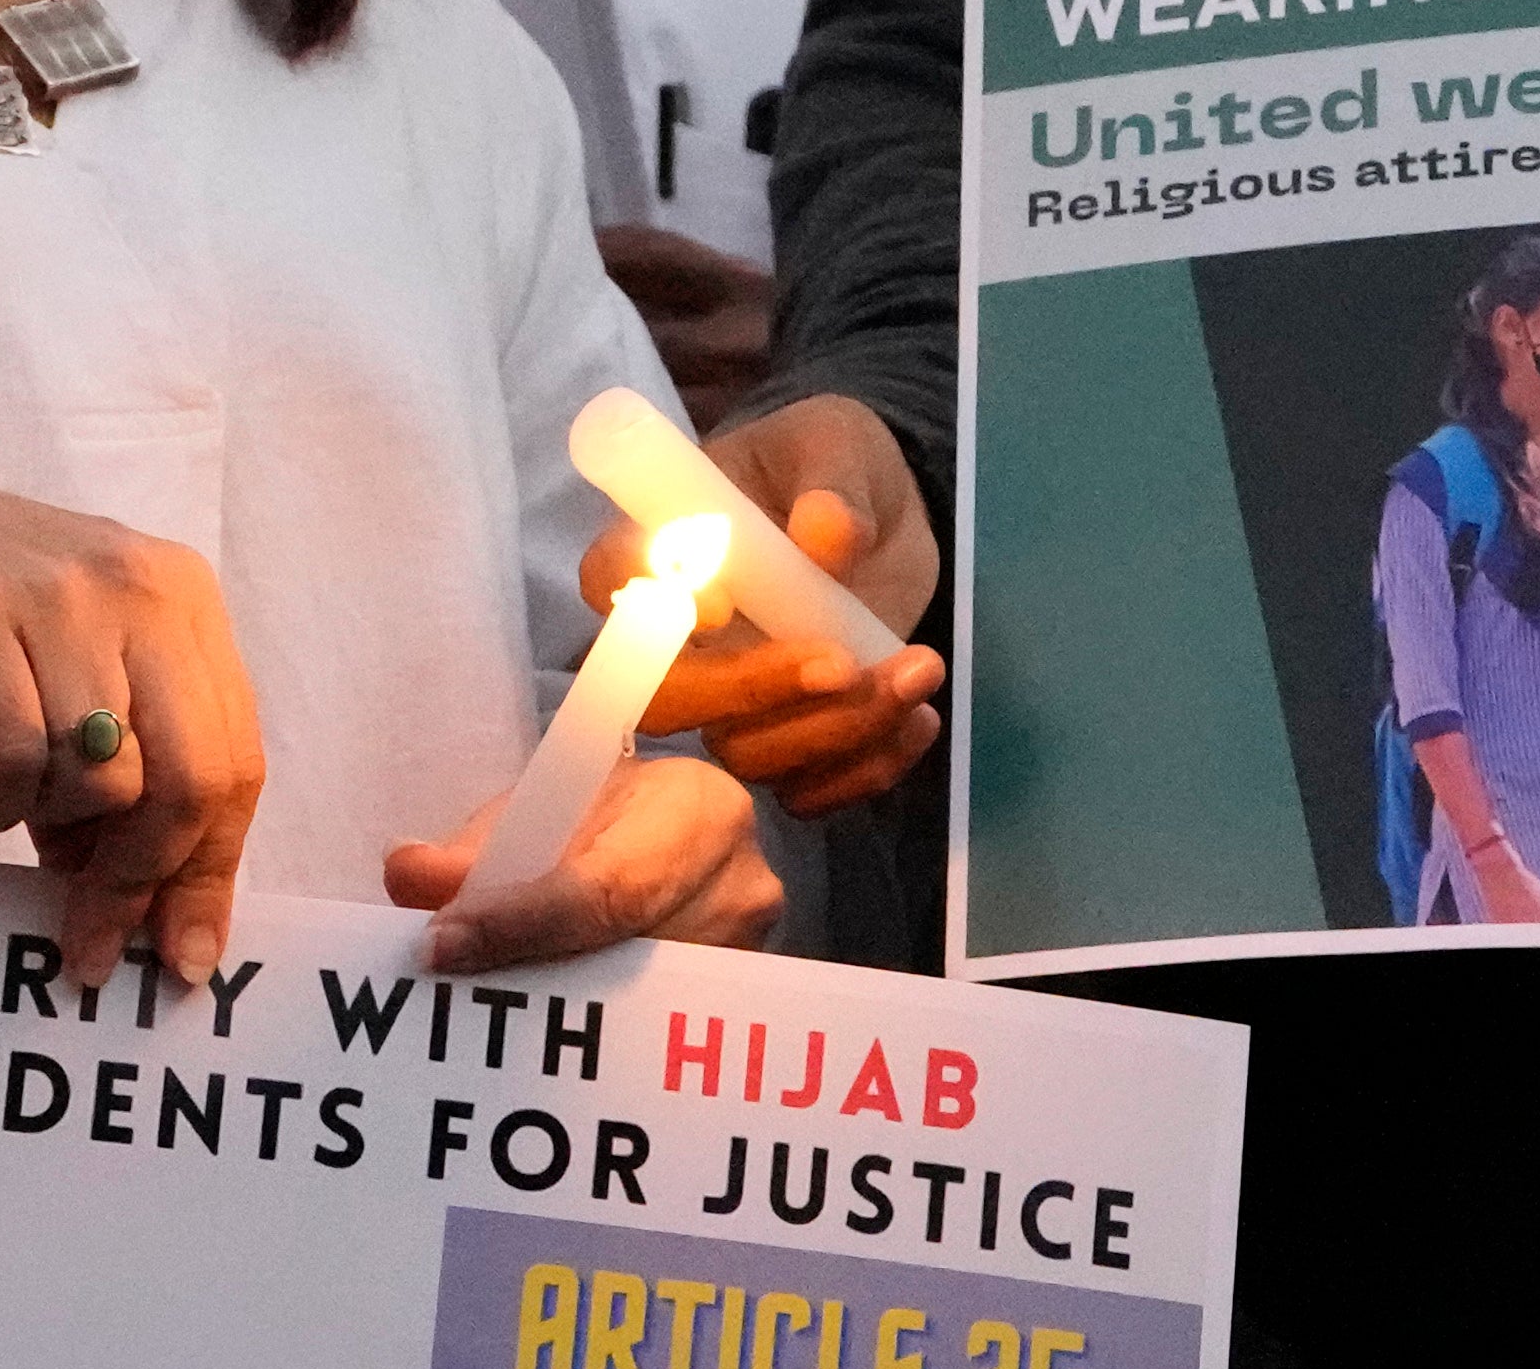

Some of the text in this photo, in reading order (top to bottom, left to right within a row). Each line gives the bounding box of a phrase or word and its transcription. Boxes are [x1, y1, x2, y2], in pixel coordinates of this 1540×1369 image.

[1030, 68, 1380, 168] United
[1026, 159, 1337, 228] Religious
[318, 967, 605, 1082] WITH
[663, 1010, 980, 1132] HIJAB
[427, 1099, 654, 1207] FOR
[702, 1135, 1136, 1271] JUSTICE
